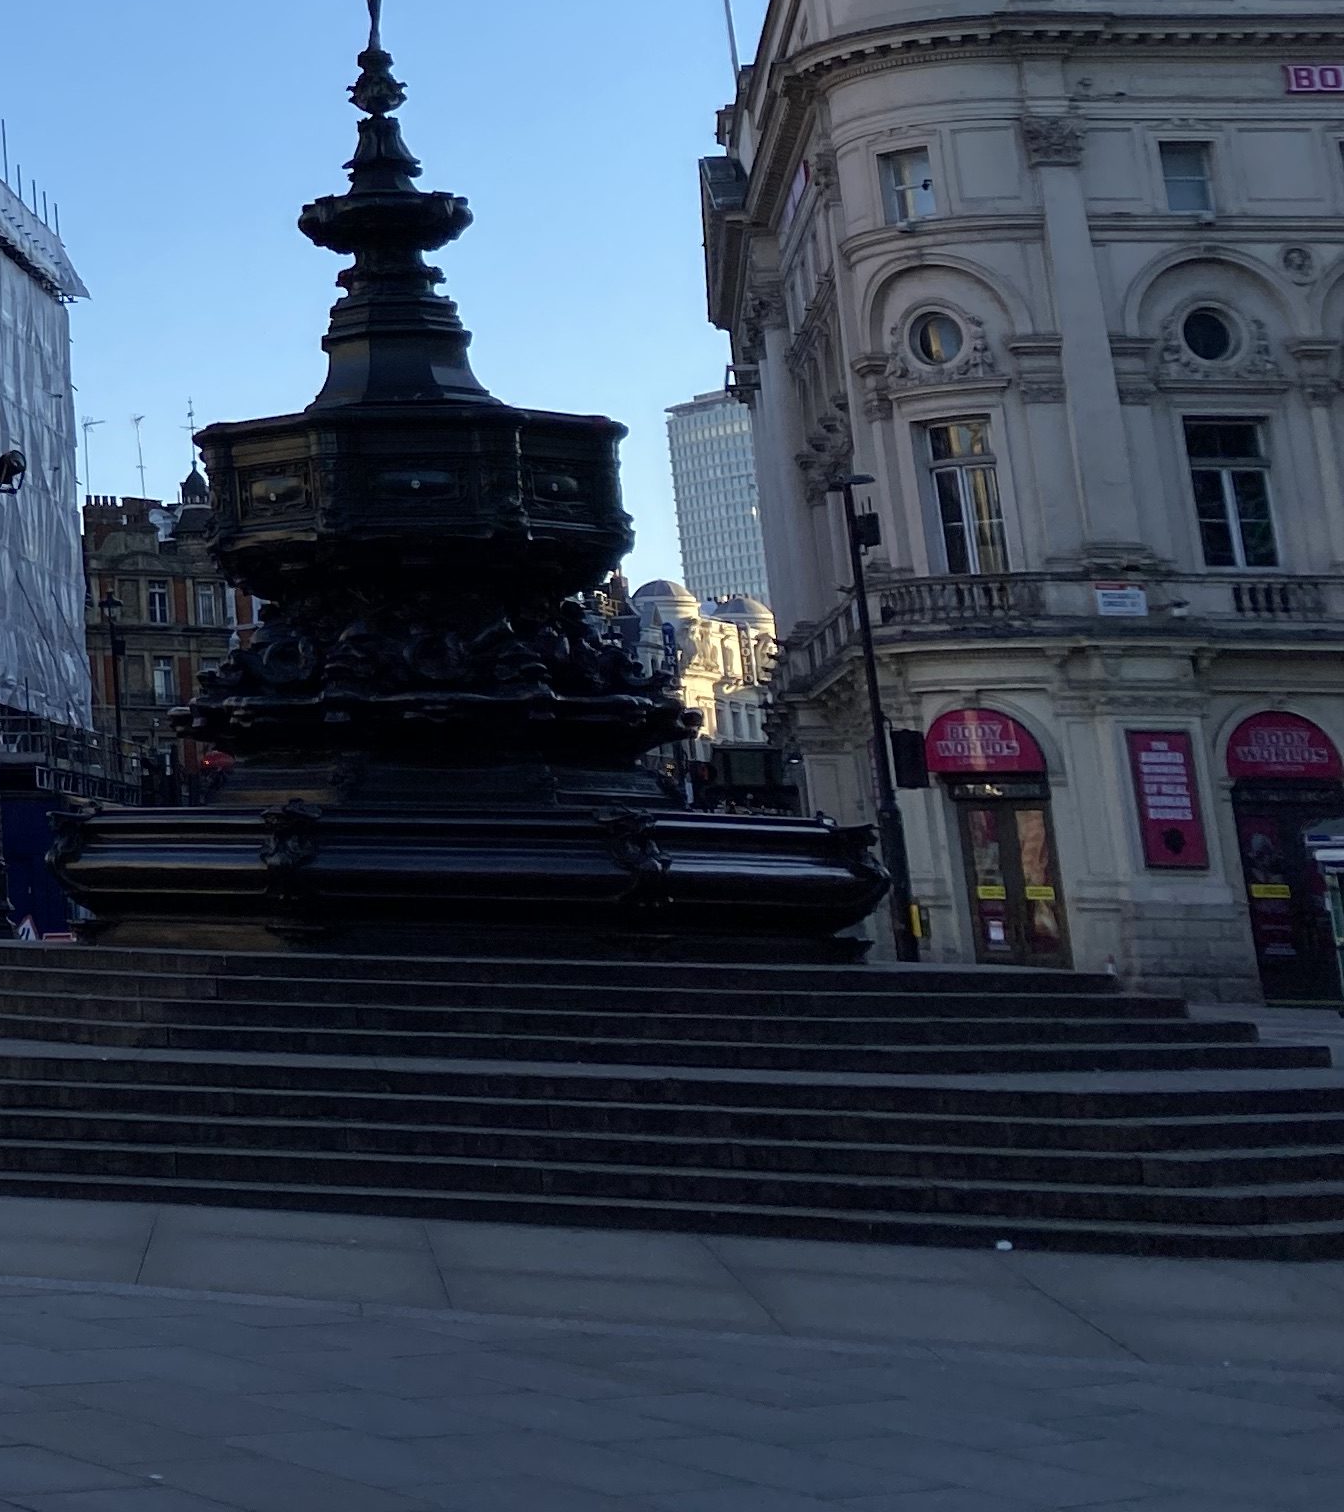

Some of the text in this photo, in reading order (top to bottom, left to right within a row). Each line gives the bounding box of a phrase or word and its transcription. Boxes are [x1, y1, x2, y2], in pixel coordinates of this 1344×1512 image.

[740, 630, 754, 683] APOLLO
[947, 723, 1002, 740] BODY
[937, 740, 1020, 756] WORLDS
